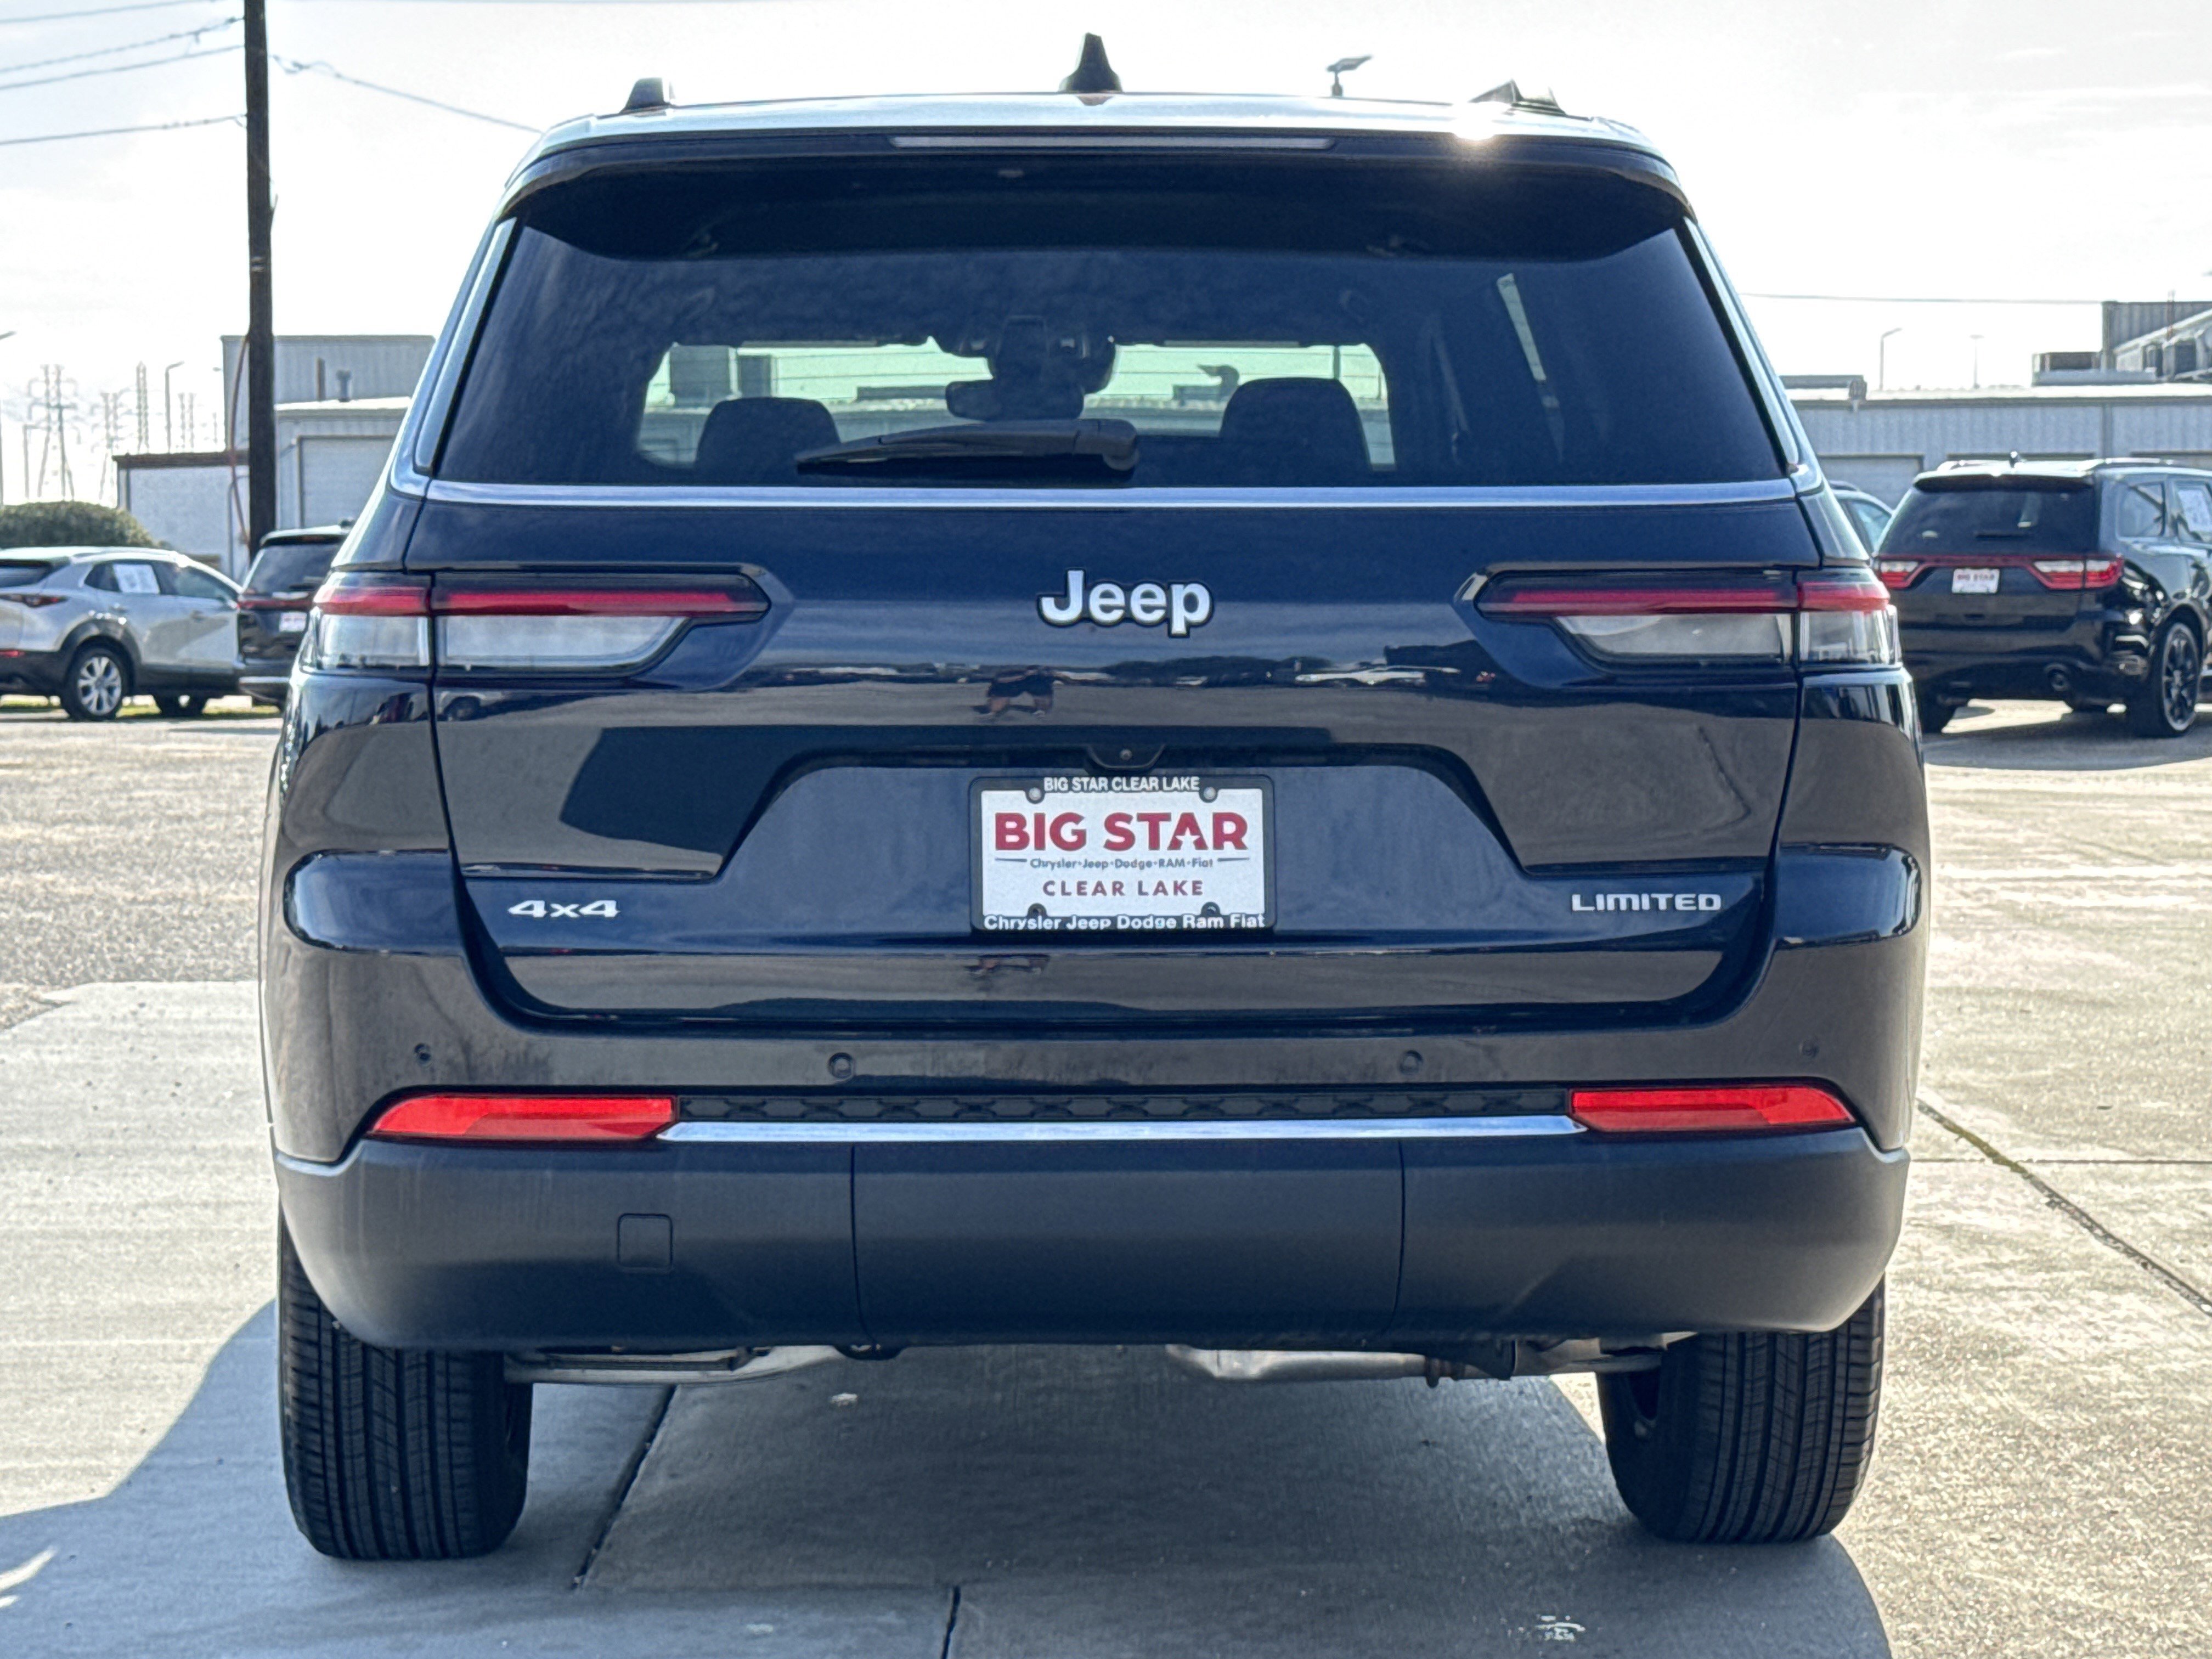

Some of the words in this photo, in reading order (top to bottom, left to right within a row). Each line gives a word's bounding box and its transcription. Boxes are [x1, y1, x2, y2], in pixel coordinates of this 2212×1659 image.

[1040, 568, 1211, 636] Jeep
[1043, 777, 1069, 792] BIG
[1071, 777, 1108, 791] STAR
[1111, 776, 1160, 791] CLEAR
[1163, 776, 1200, 791] LAKE
[995, 812, 1087, 851] BIG
[1103, 812, 1249, 851] STAR
[1043, 880, 1125, 896] CLEAR
[1137, 880, 1204, 896] LAKE
[507, 900, 621, 918] 4x4
[1571, 893, 1722, 911] LIMITED
[984, 916, 1062, 930] Chrysler
[1066, 916, 1111, 930] Jeep
[1117, 915, 1177, 929] Dodge
[1182, 914, 1224, 929] Ram
[1229, 913, 1266, 928] Fiat
